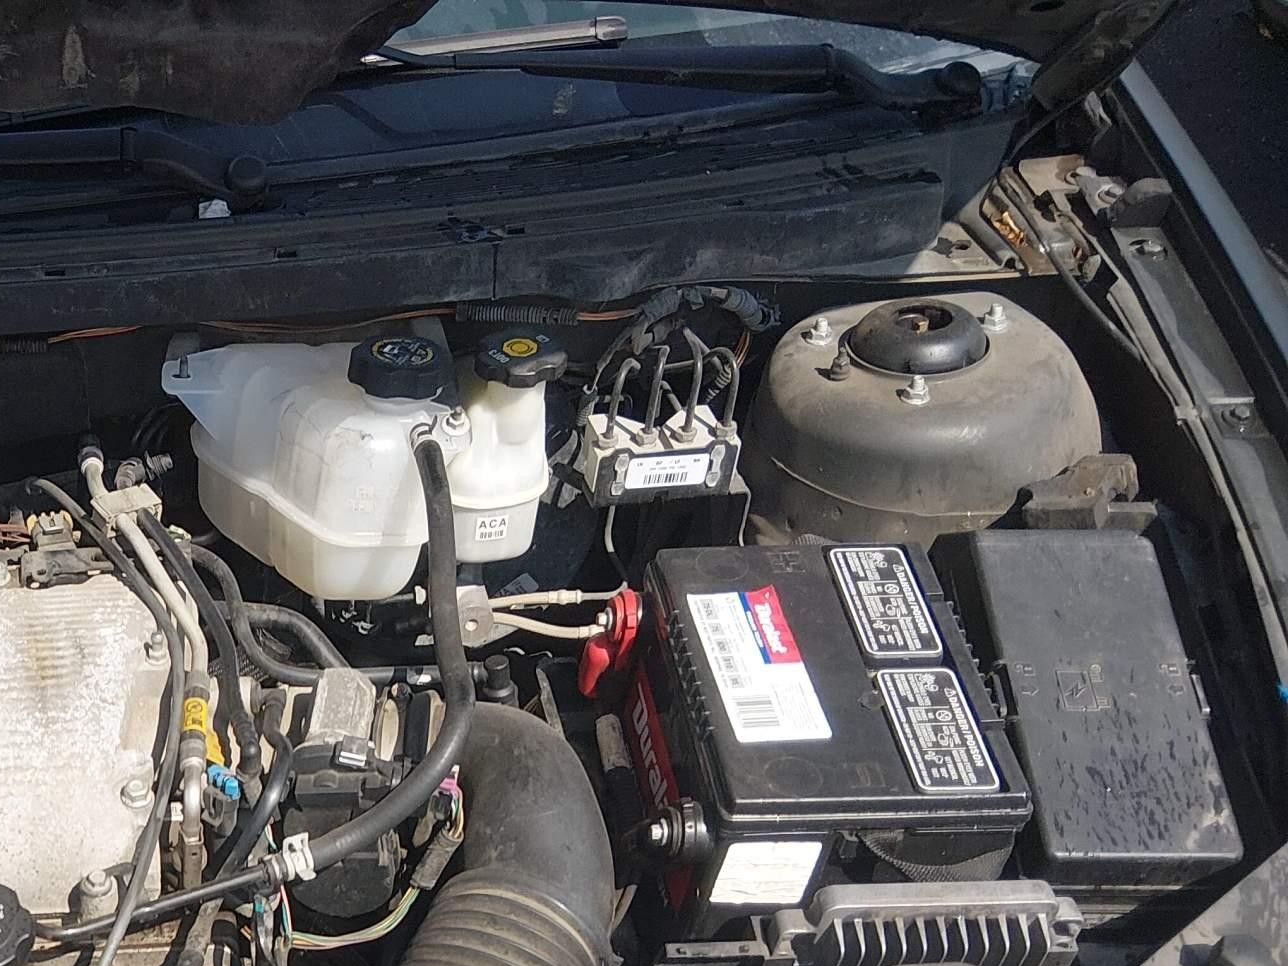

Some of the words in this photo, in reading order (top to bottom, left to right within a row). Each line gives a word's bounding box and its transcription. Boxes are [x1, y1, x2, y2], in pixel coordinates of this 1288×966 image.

[478, 518, 506, 529] ACA
[896, 572, 929, 633] DANGER/POISON
[632, 682, 670, 811] Dural
[948, 696, 985, 766] DANGER/POISON
